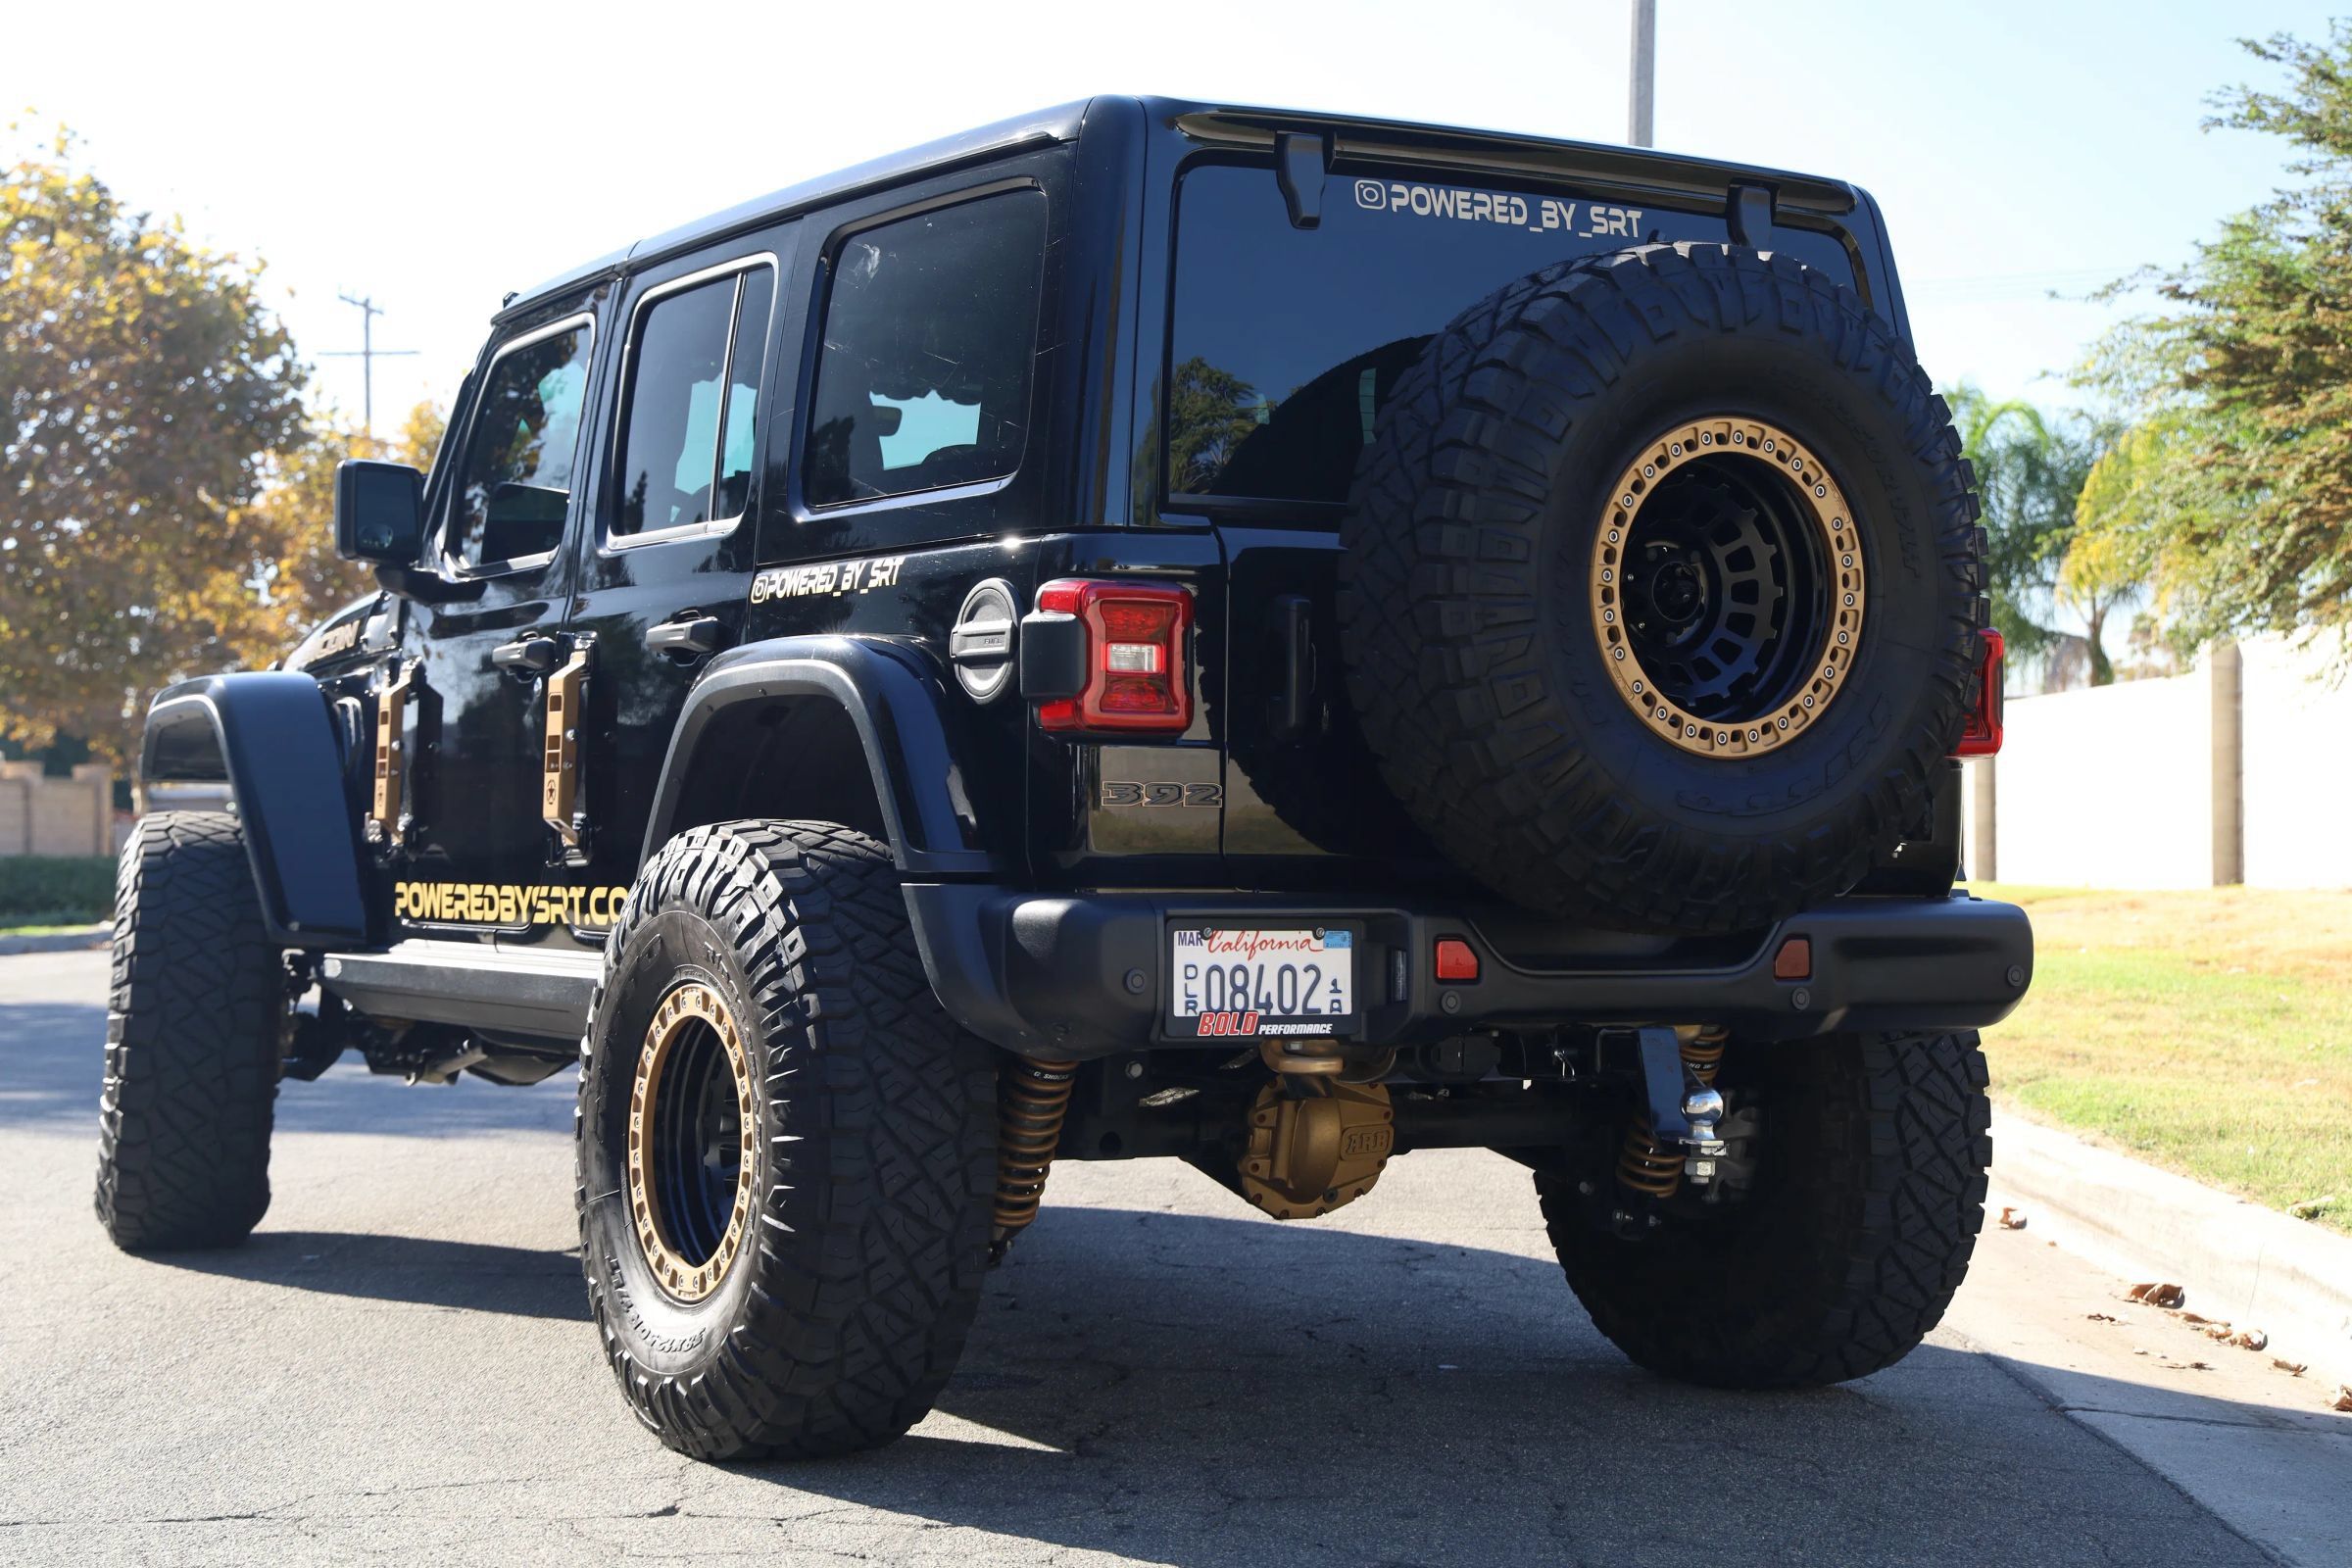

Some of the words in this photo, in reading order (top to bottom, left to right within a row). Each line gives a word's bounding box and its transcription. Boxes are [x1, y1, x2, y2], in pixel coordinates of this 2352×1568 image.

[1391, 184, 1642, 237] POWERED_BY_SRT
[765, 557, 906, 597] POWERED_BY_SRT
[1102, 781, 1222, 808] 392
[1178, 931, 1203, 947] MAR
[1207, 929, 1324, 961] California
[1205, 963, 1322, 1014] 08402
[1198, 1011, 1259, 1037] BOLD
[1258, 1023, 1333, 1035] PERFORMANCE
[1345, 1129, 1391, 1155] ARB
